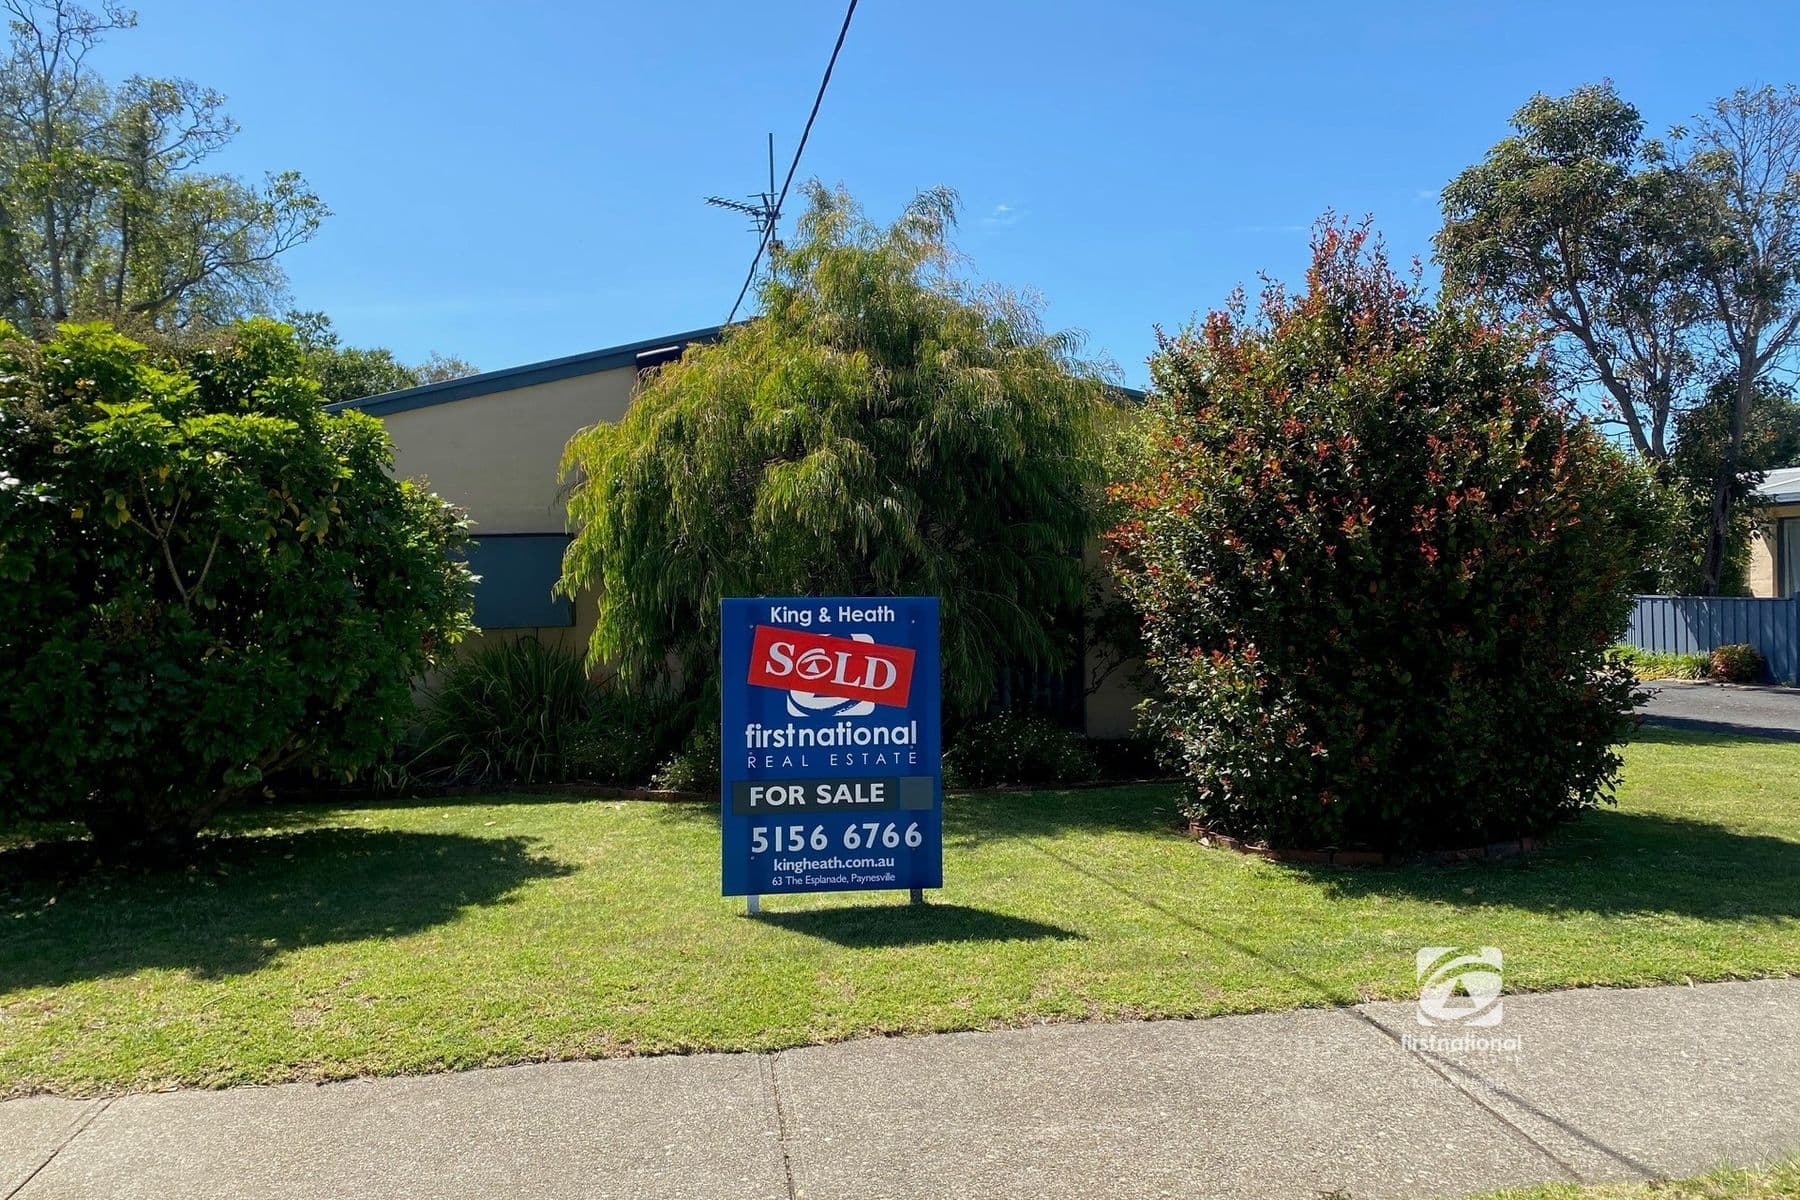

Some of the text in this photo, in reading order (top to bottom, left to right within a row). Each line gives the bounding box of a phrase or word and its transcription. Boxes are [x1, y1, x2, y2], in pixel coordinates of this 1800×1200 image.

[770, 605, 895, 627] King & Heath
[765, 641, 897, 690] SOLD
[747, 752, 917, 768] REAL ESTATE
[750, 783, 885, 807] FOR SALE
[751, 821, 923, 854] 5156 6766
[773, 856, 895, 874] kingheath.com.au
[772, 872, 896, 886] 63 The Esplanade, Paynesville
